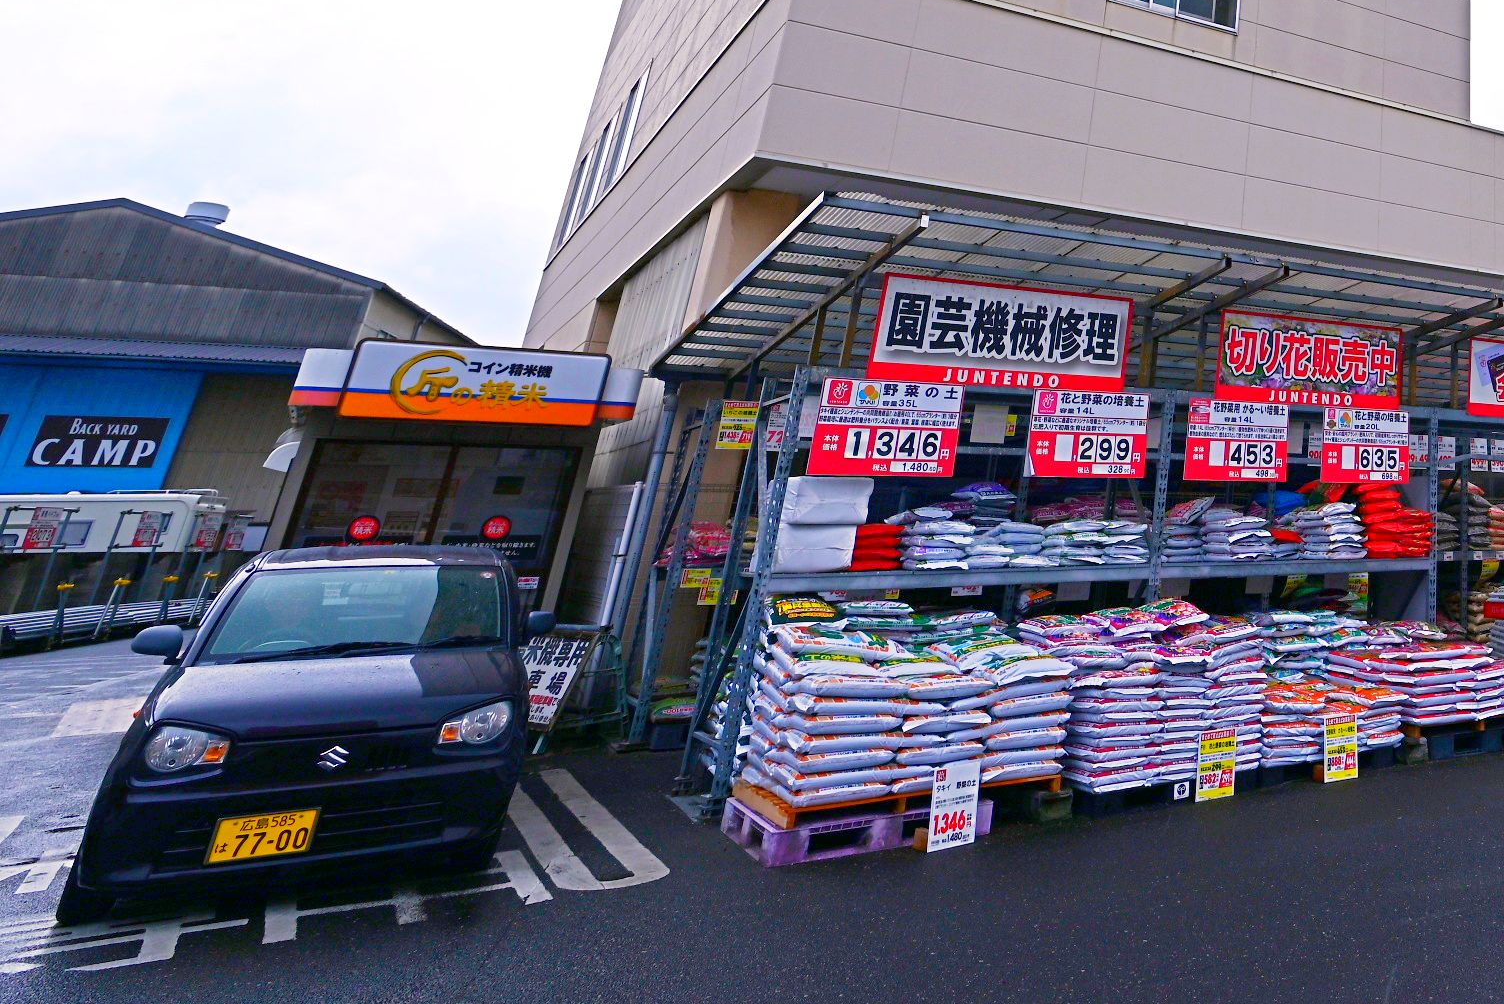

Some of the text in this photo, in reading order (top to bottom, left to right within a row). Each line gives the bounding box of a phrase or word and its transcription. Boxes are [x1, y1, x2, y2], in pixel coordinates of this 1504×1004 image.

[885, 291, 1120, 364] 園芸機械修理
[1226, 325, 1397, 386] 切り花販売中
[467, 360, 553, 378] コイン精米機
[943, 368, 1061, 387] JUNTENDO
[882, 383, 958, 400] 野菜の土
[1060, 392, 1145, 407] 花と野菜の培養土
[1268, 390, 1353, 406] JUNTENDO
[1354, 410, 1407, 423] 花と野菜の培養土
[69, 417, 139, 436] BACK YARD
[822, 443, 839, 451] 価格
[824, 434, 840, 442] 本体
[31, 438, 157, 466] CAMP
[519, 637, 590, 667] 米機専用
[240, 814, 296, 832] 広島 585
[214, 827, 309, 858] は 77-00
